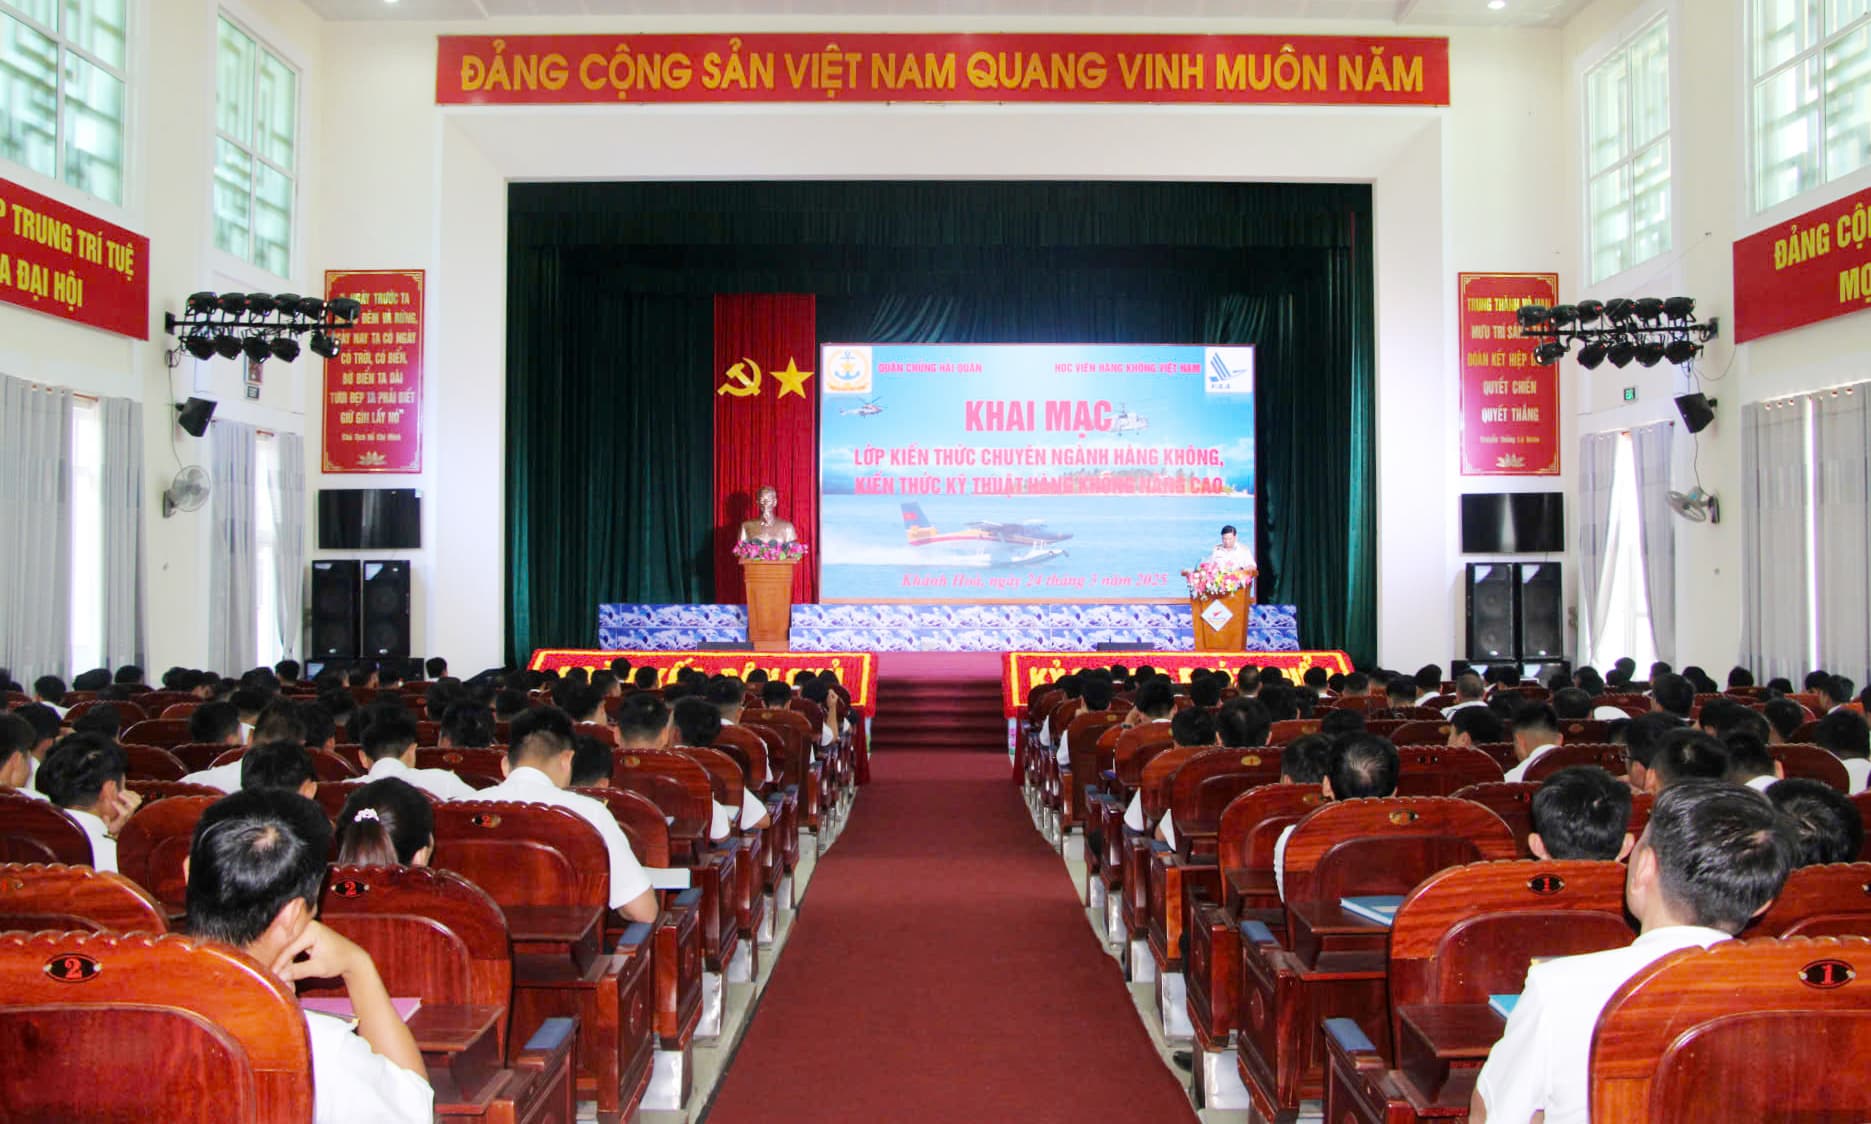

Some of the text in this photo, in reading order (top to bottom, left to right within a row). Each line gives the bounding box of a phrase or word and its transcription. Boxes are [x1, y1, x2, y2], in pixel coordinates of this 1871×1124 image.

[460, 36, 1424, 100] ĐẢNG CỘNG SẢN VIỆT NAM QUANG VINH MUÔN NĂM
[11, 203, 74, 255] TRUNG
[76, 227, 104, 265] TRÍ
[105, 241, 136, 282] TUỆ
[1774, 224, 1831, 271] ĐẢNG
[16, 258, 50, 302] ĐẠI
[53, 269, 84, 312] HỘI
[1467, 297, 1492, 312] TRUNG
[965, 399, 1113, 439] KHAI MẠC
[1481, 403, 1508, 424] QUYẾT
[854, 442, 1225, 468] LỚP KIẾN THỨC CHUYÊN NGÀNH HÀNG KHÔNG,
[855, 470, 895, 495] KIẾN
[899, 471, 941, 495] THỨC
[972, 473, 1025, 498] THUẬT
[1189, 477, 1224, 494] CAO
[1136, 572, 1169, 588] 2025
[344, 880, 357, 897] 2
[64, 957, 84, 980] 2
[1821, 964, 1835, 985] 1
